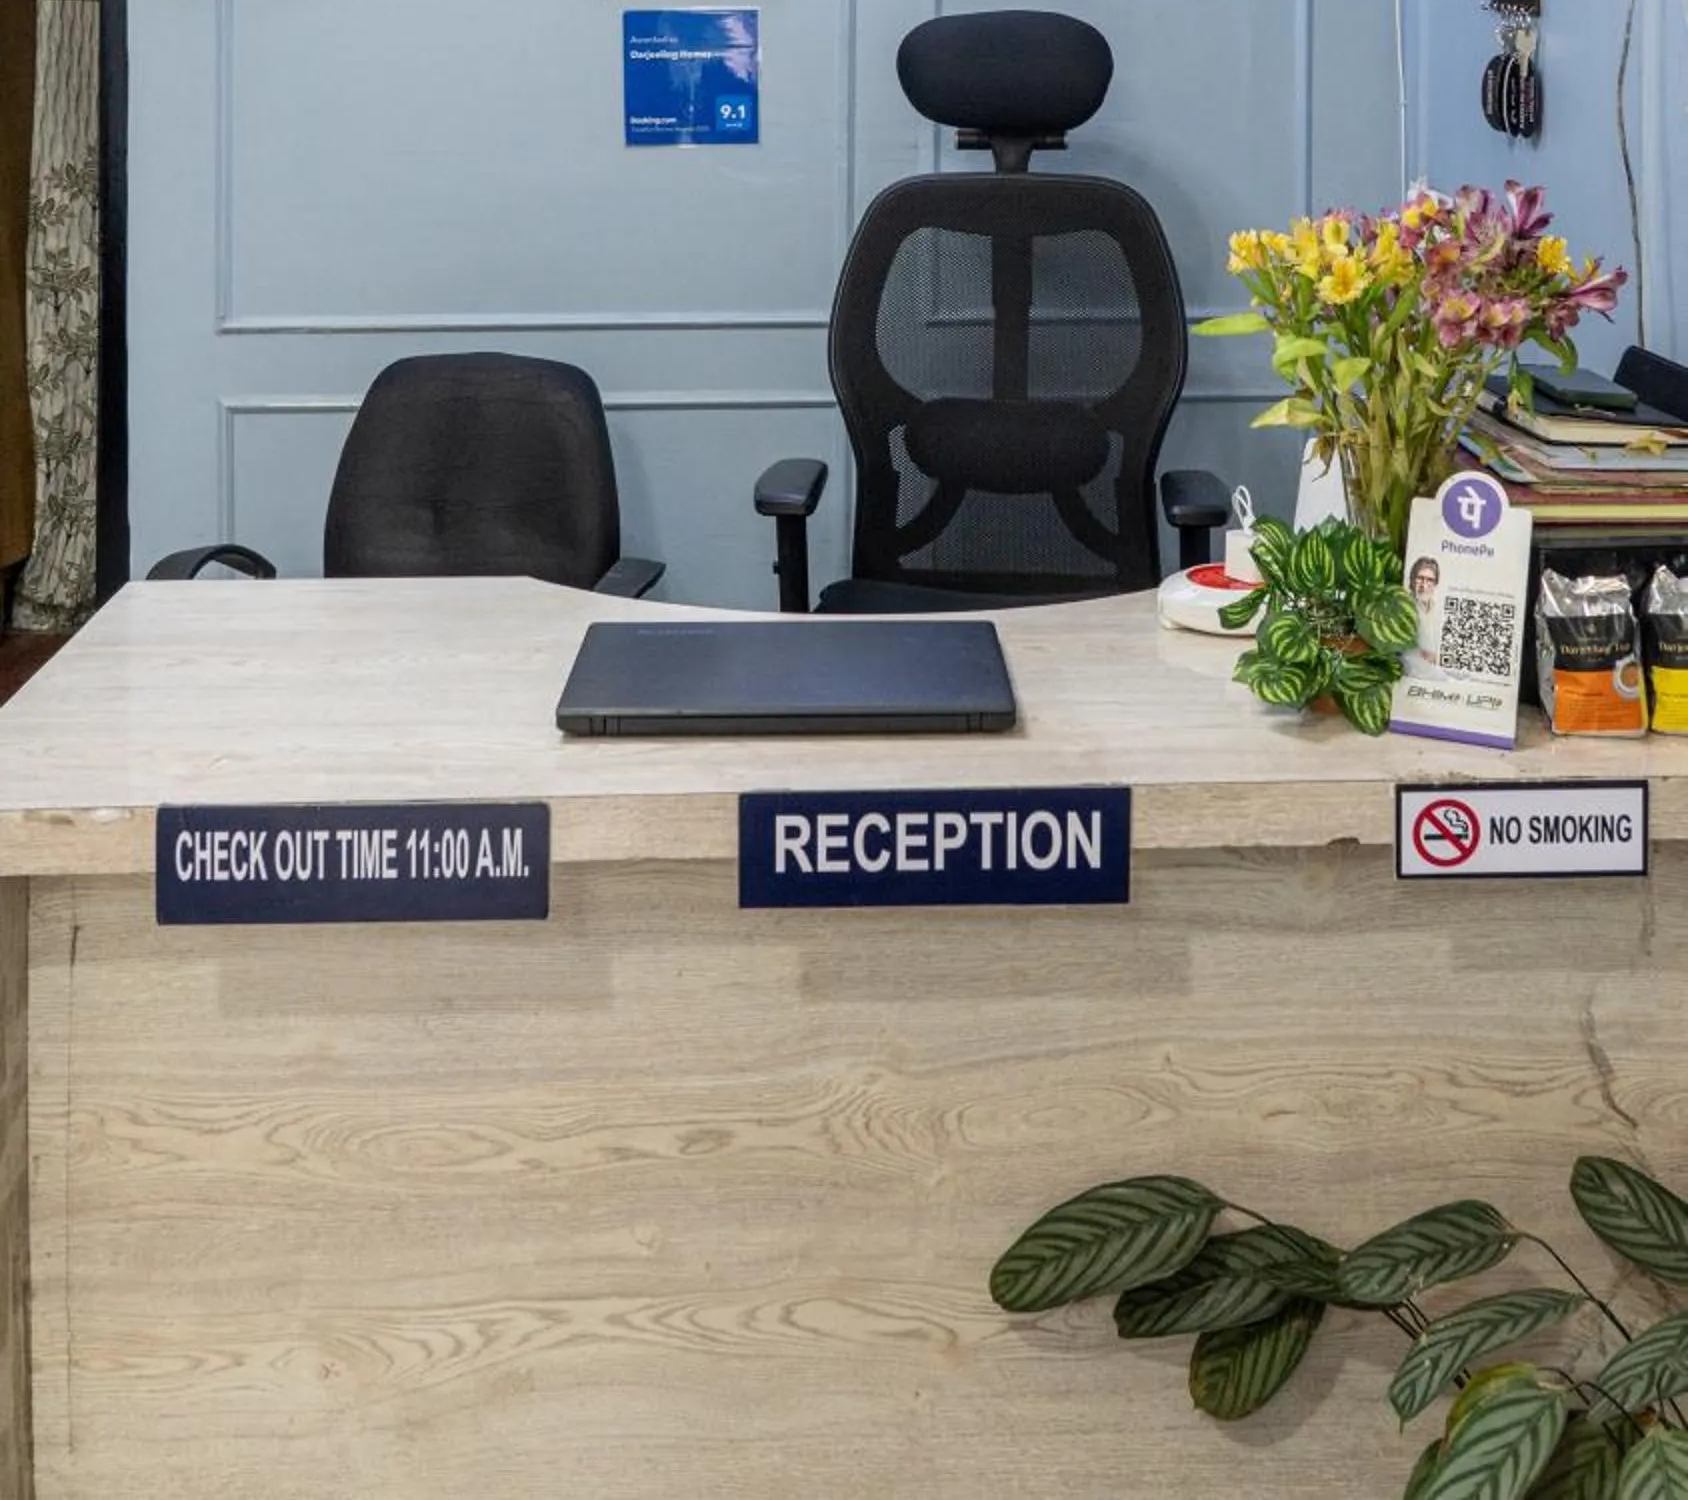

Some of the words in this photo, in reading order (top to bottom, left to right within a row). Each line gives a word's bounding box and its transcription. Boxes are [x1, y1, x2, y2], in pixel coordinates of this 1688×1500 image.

[720, 104, 746, 119] 9.1
[1441, 539, 1495, 557] PhonePe
[774, 810, 1101, 874] RECEPTION
[1489, 815, 1522, 844] NO
[1529, 814, 1633, 844] SMOKING
[174, 830, 268, 882] CHECK
[274, 830, 330, 881] OUT
[336, 829, 398, 879] TIME
[406, 828, 469, 879] 11:00
[475, 827, 530, 879] A.M.
